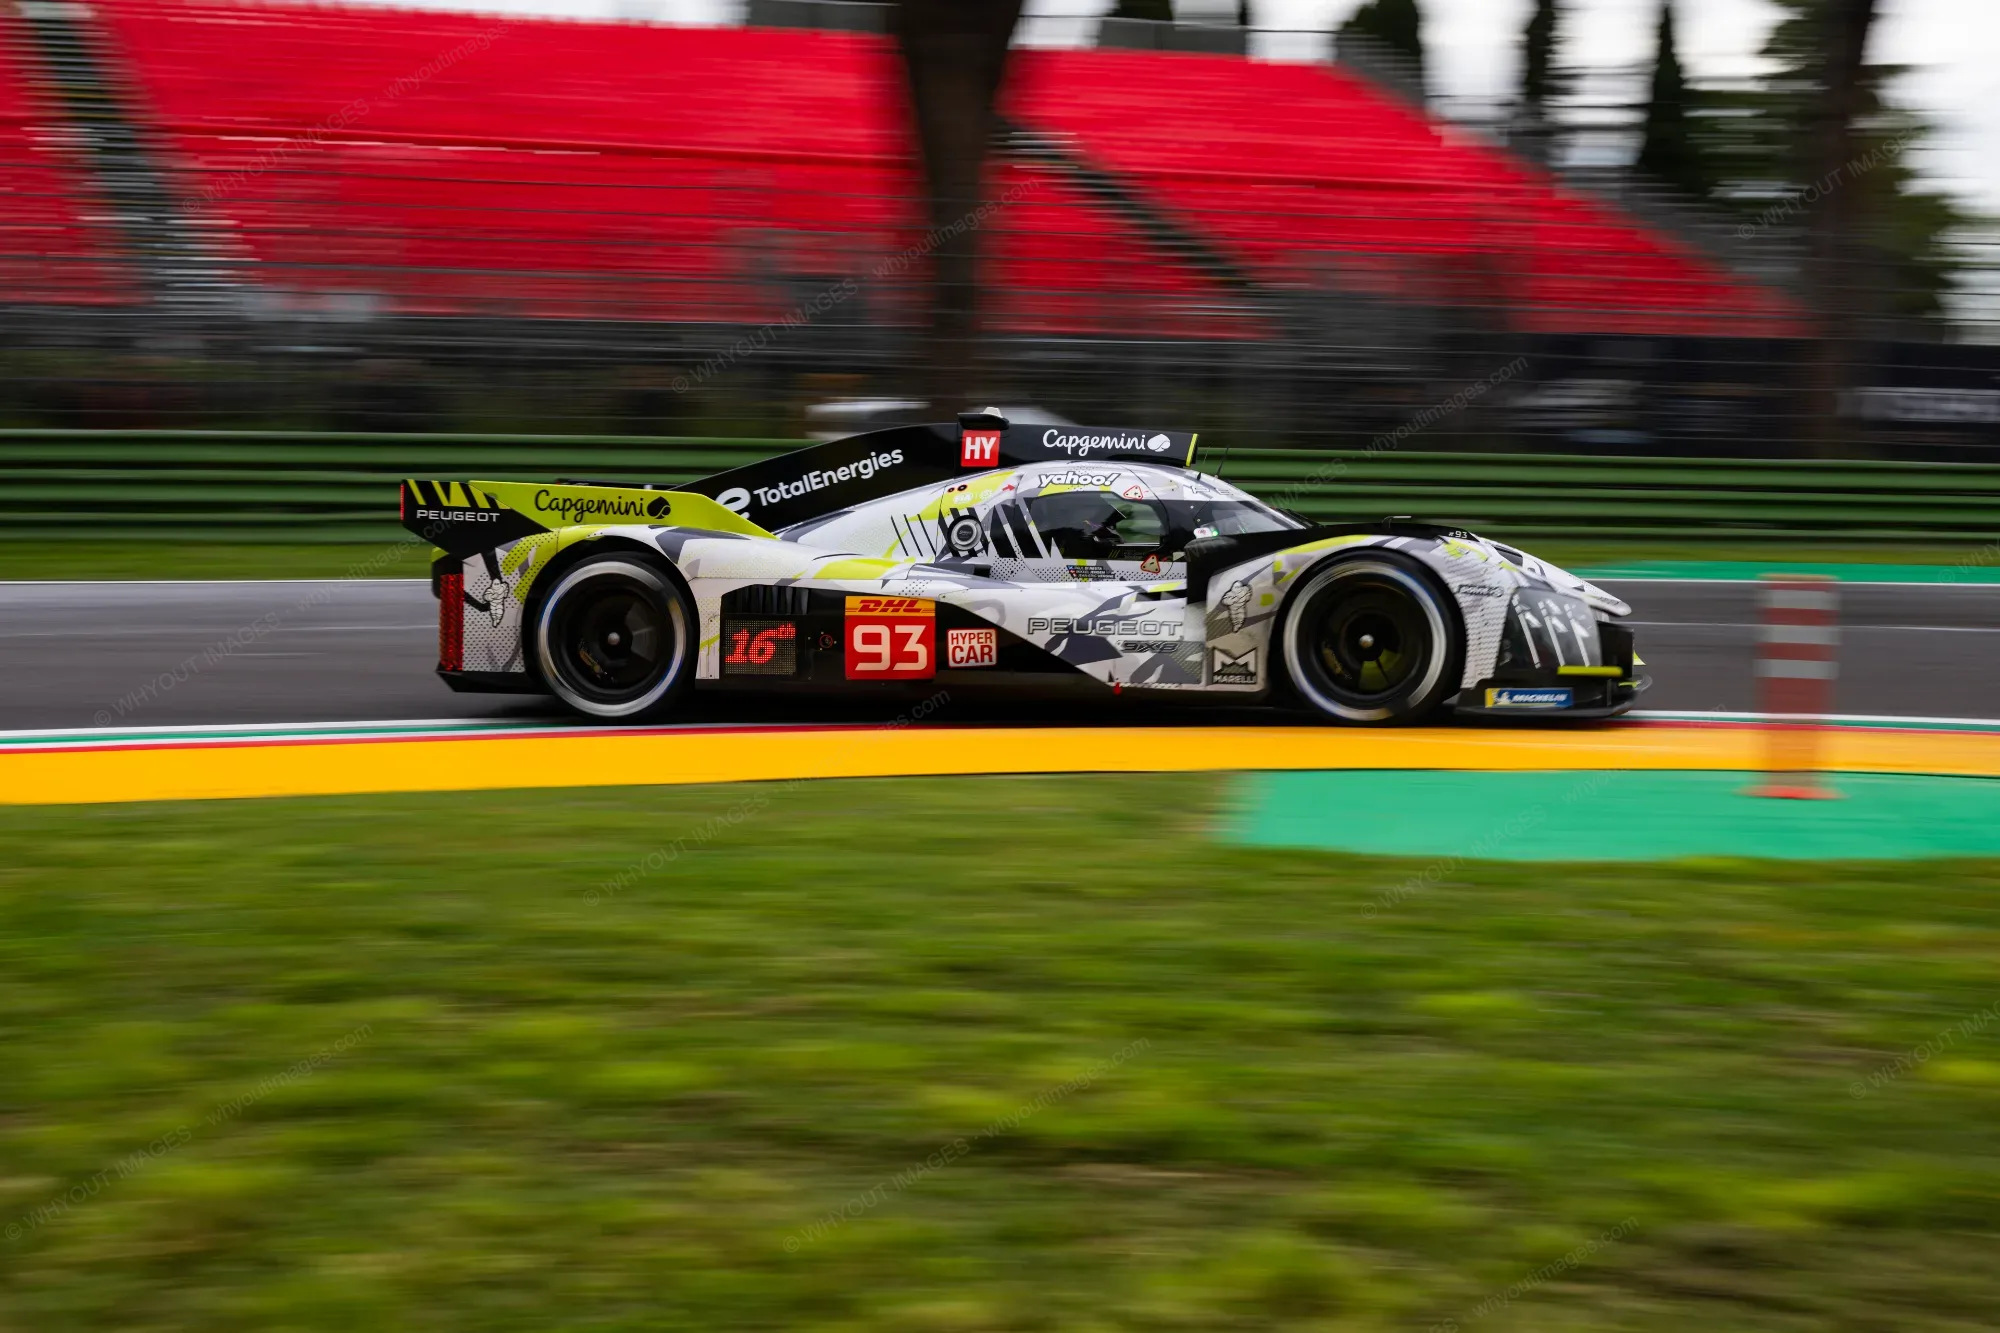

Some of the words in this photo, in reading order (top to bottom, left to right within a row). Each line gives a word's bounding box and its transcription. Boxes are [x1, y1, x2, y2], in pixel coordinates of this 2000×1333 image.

[964, 436, 997, 460] HY
[1042, 429, 1146, 456] Capgemini
[753, 449, 904, 507] TotalEnergies
[1038, 471, 1121, 488] yahoo!
[534, 489, 645, 523] Capgemini
[416, 509, 500, 523] PEUGEOT
[856, 600, 923, 613] DHL
[1027, 617, 1183, 636] PEUGEOT
[852, 624, 928, 671] 93
[950, 631, 993, 646] HYPER
[1121, 640, 1180, 654] 9X8
[951, 645, 993, 665] CAR
[1213, 674, 1257, 684] MARELLI
[1511, 693, 1568, 702] MICHELIN
